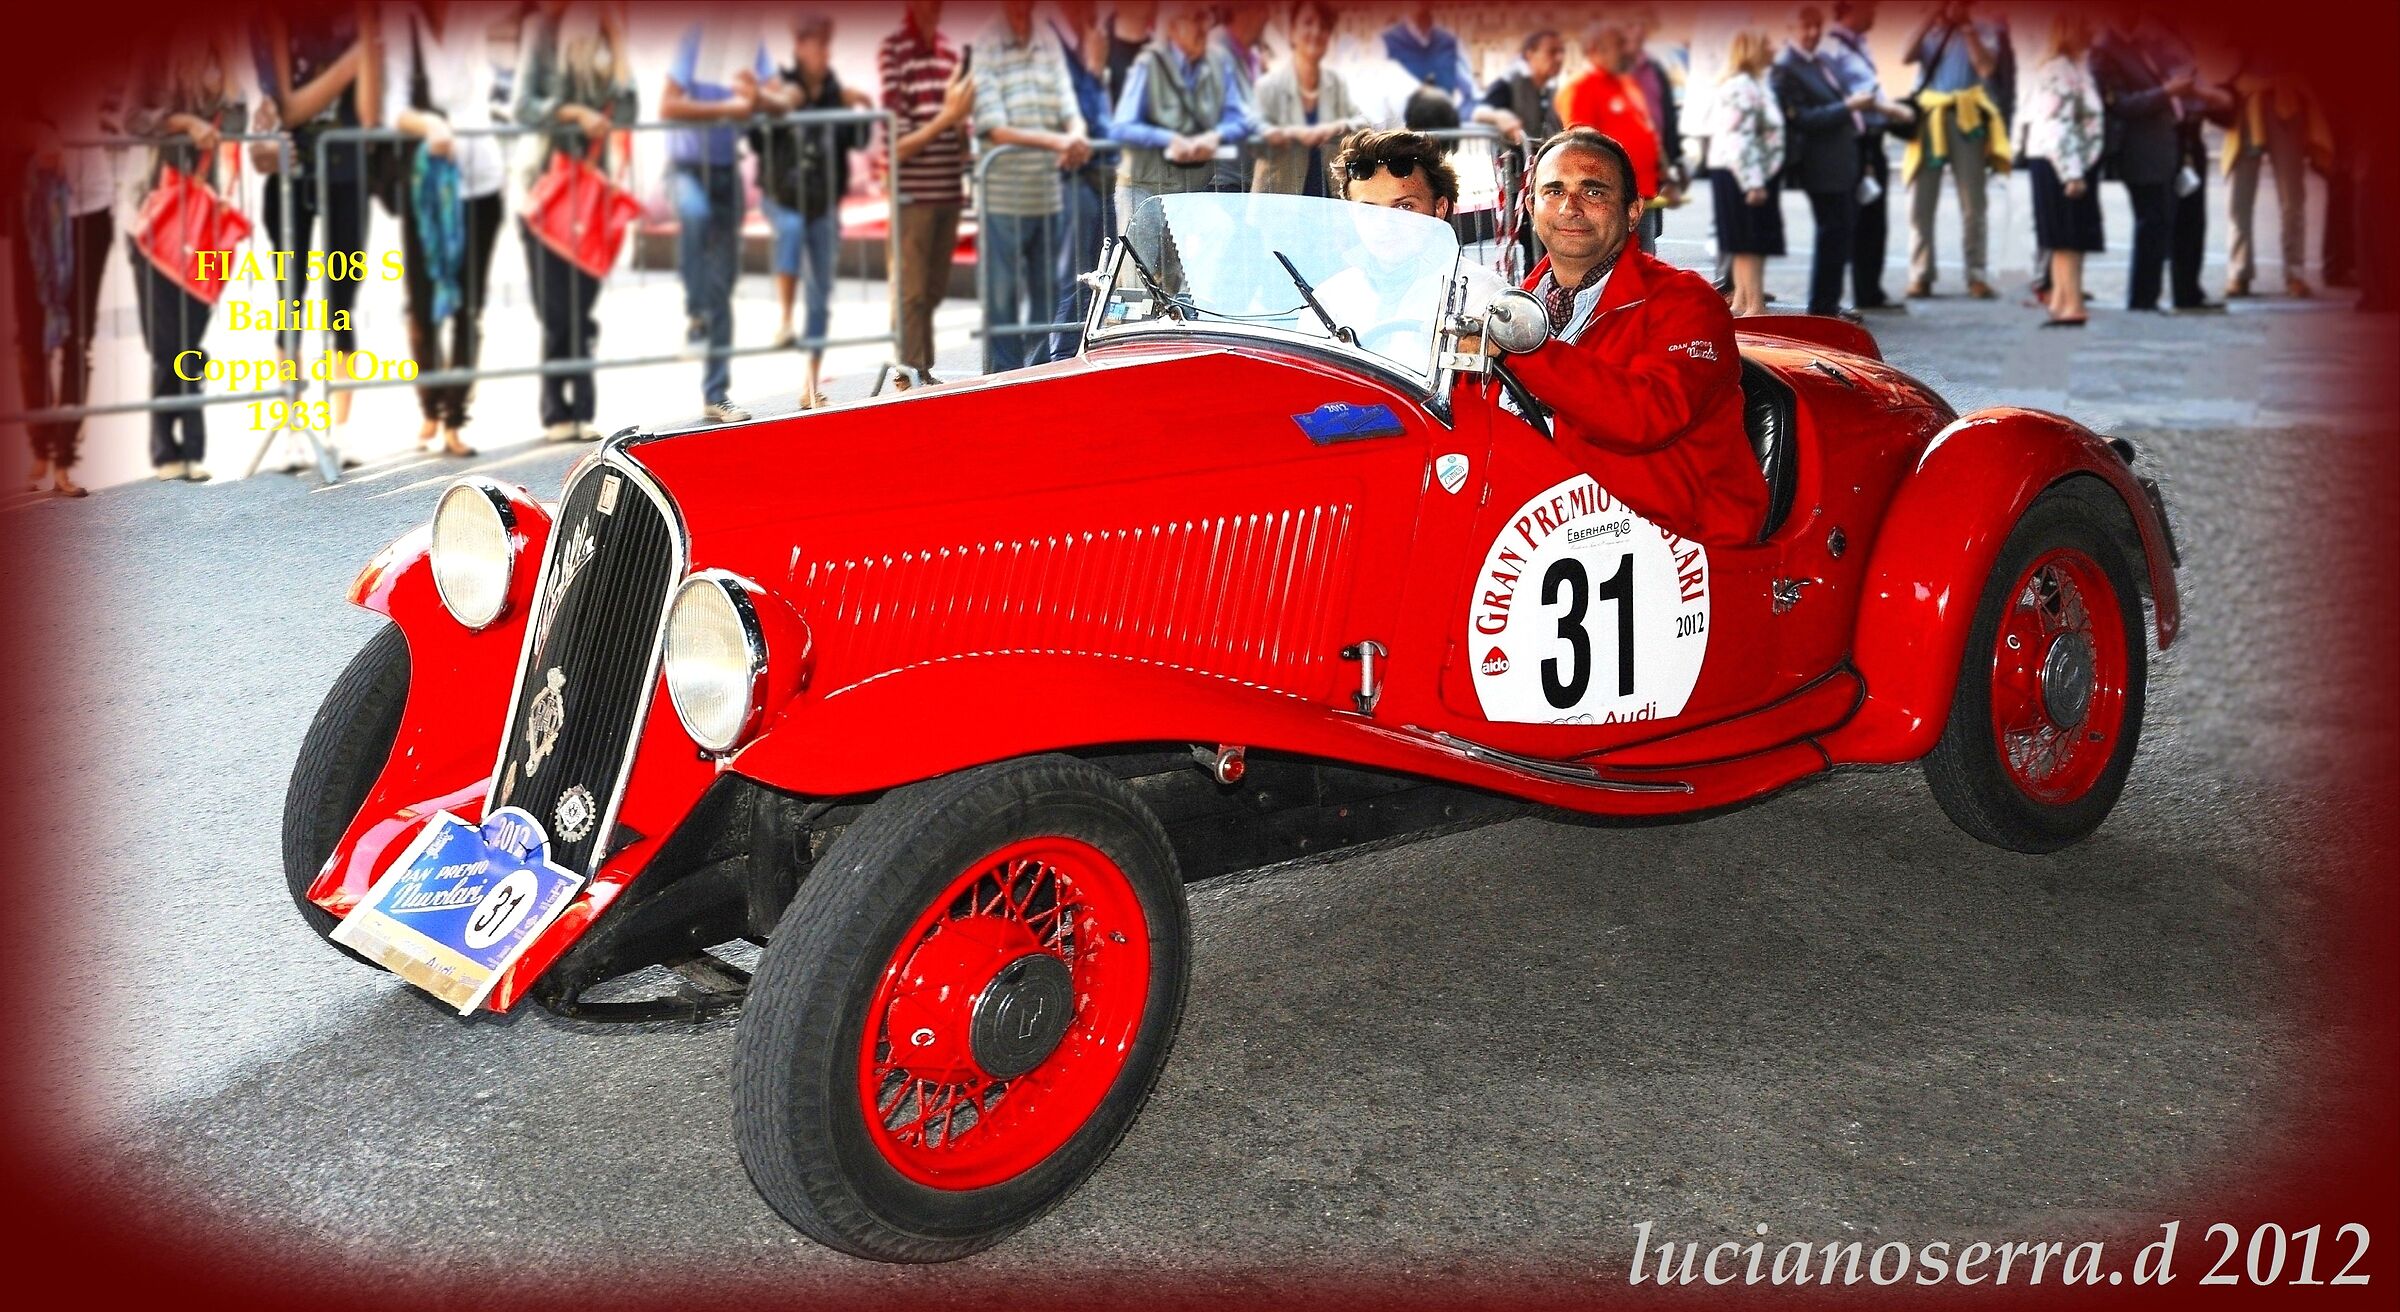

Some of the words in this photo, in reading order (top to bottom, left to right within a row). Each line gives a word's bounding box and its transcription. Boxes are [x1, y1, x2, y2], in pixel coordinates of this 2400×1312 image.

[1567, 521, 1619, 541] EBERHARD
[1475, 545, 1527, 635] GRAN
[1513, 483, 1611, 551] PREMIO
[1540, 553, 1634, 710] 31
[1675, 611, 1705, 639] 2012
[1481, 657, 1510, 675] aido
[1603, 701, 1657, 724] Audi
[489, 816, 532, 862] 2012
[474, 885, 526, 937] 31
